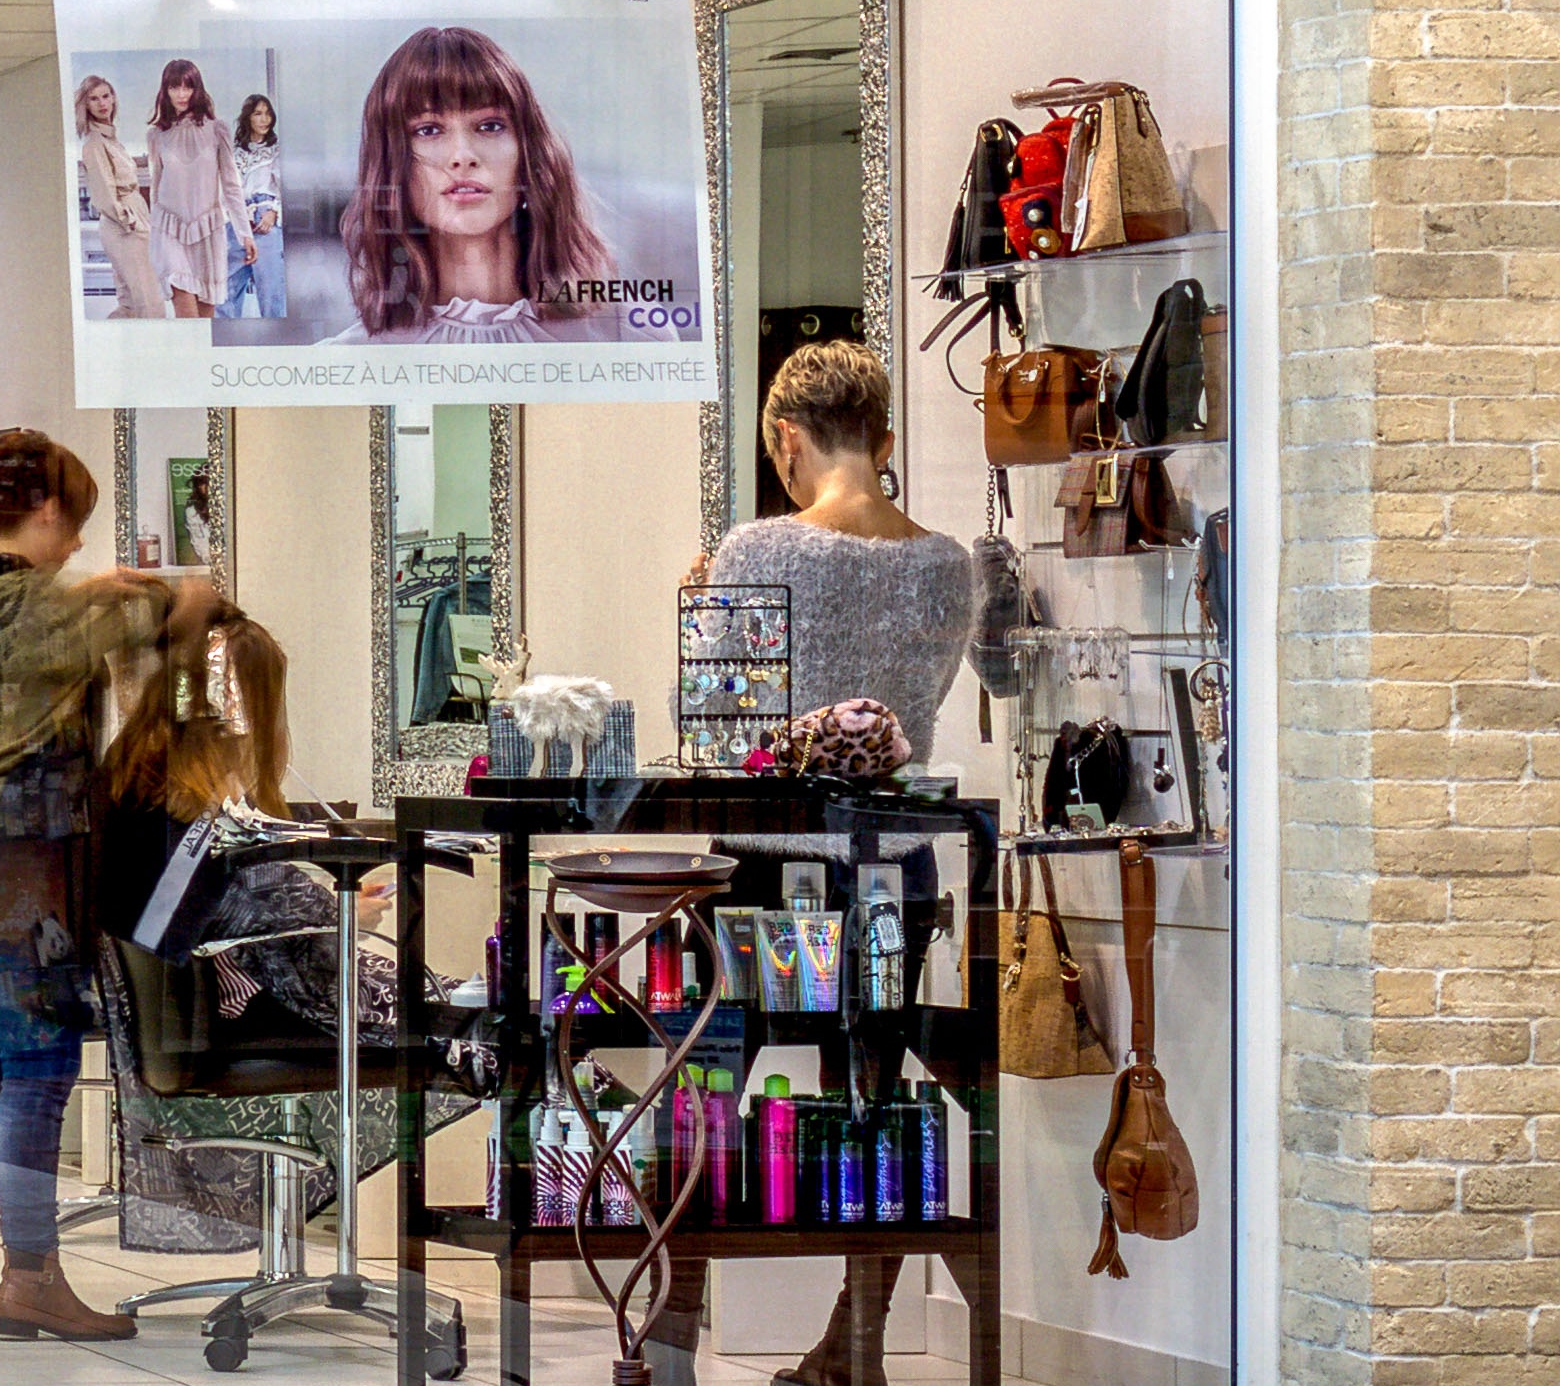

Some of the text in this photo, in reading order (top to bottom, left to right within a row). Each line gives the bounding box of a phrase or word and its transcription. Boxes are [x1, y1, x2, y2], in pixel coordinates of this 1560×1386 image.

[576, 279, 673, 303] FRENCH
[628, 302, 701, 328] cool
[211, 358, 707, 388] SUCCOMBEZ À LA TENDANCE DE LA RENTRÉE
